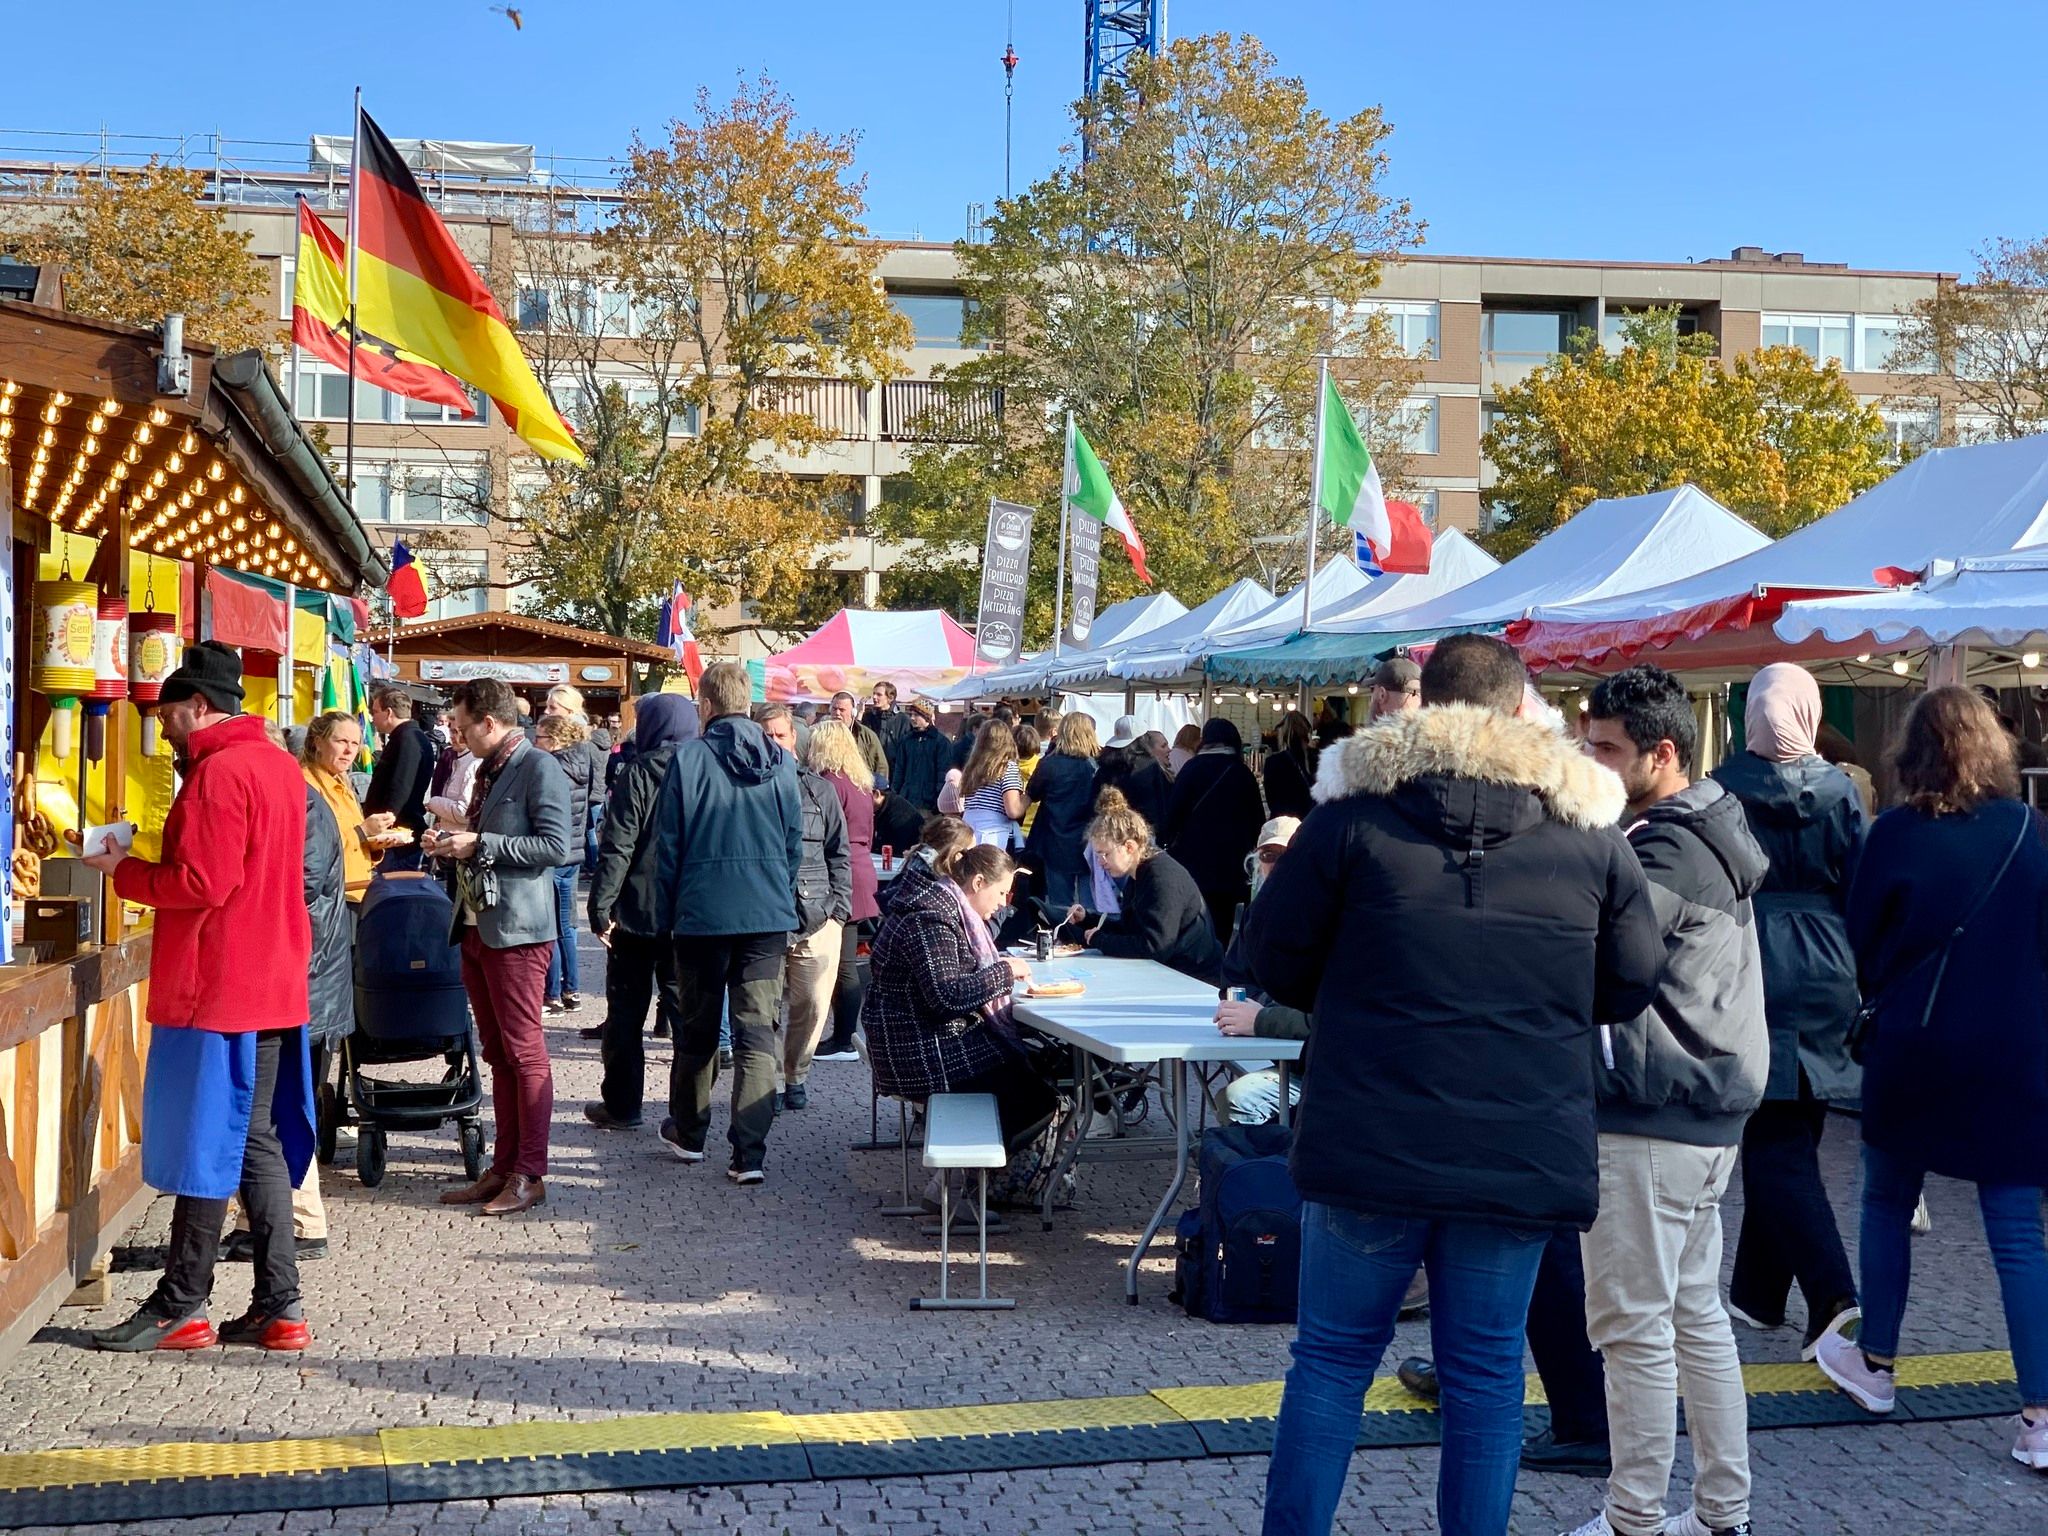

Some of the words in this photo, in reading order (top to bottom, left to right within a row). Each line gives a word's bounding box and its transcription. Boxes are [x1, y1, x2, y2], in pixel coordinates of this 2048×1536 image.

[1078, 518, 1097, 535] PIZZA
[996, 555, 1019, 570] PIZZA
[987, 568, 1025, 586] FRITTERAD
[993, 588, 1014, 601] PIZZA
[983, 600, 1021, 616] METERLÅNG
[70, 623, 90, 635] Senf
